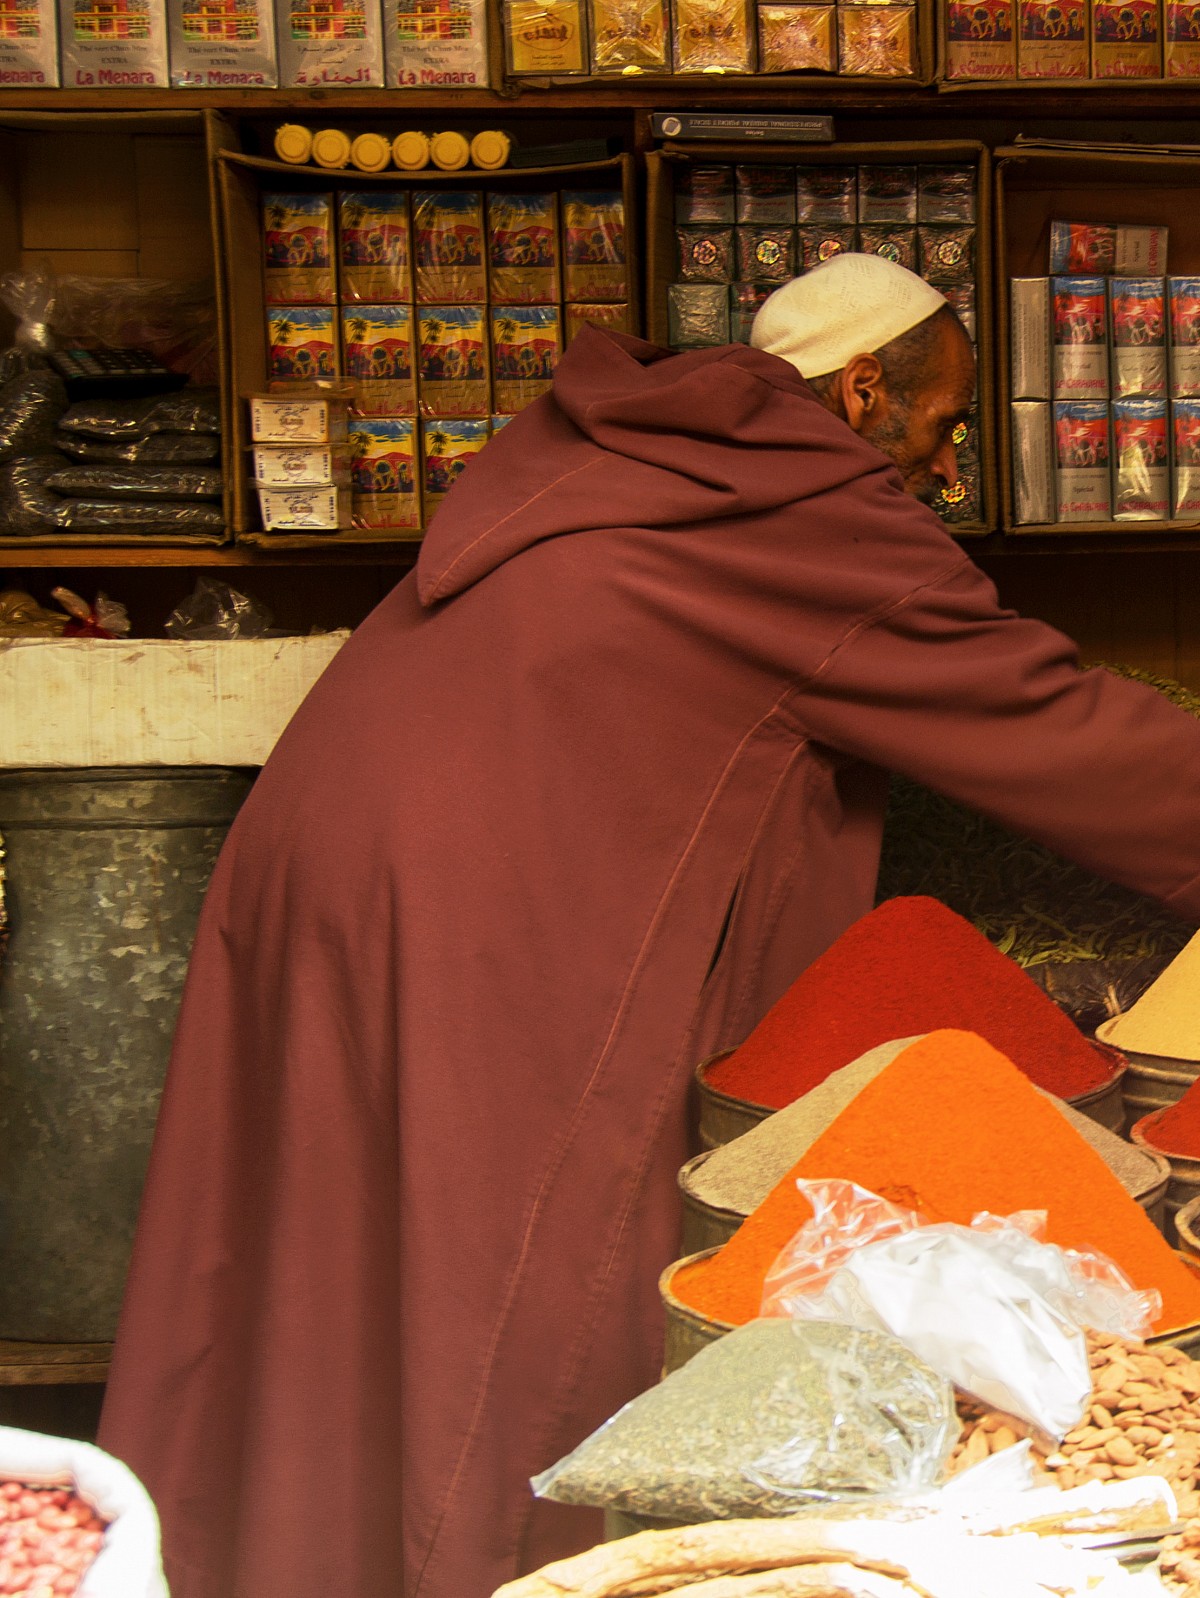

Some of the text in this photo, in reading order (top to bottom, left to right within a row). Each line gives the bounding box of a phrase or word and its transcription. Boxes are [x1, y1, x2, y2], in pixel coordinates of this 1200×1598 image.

[75, 69, 155, 85] La Menara
[207, 70, 265, 85] Menara
[399, 69, 477, 85] La Menara
